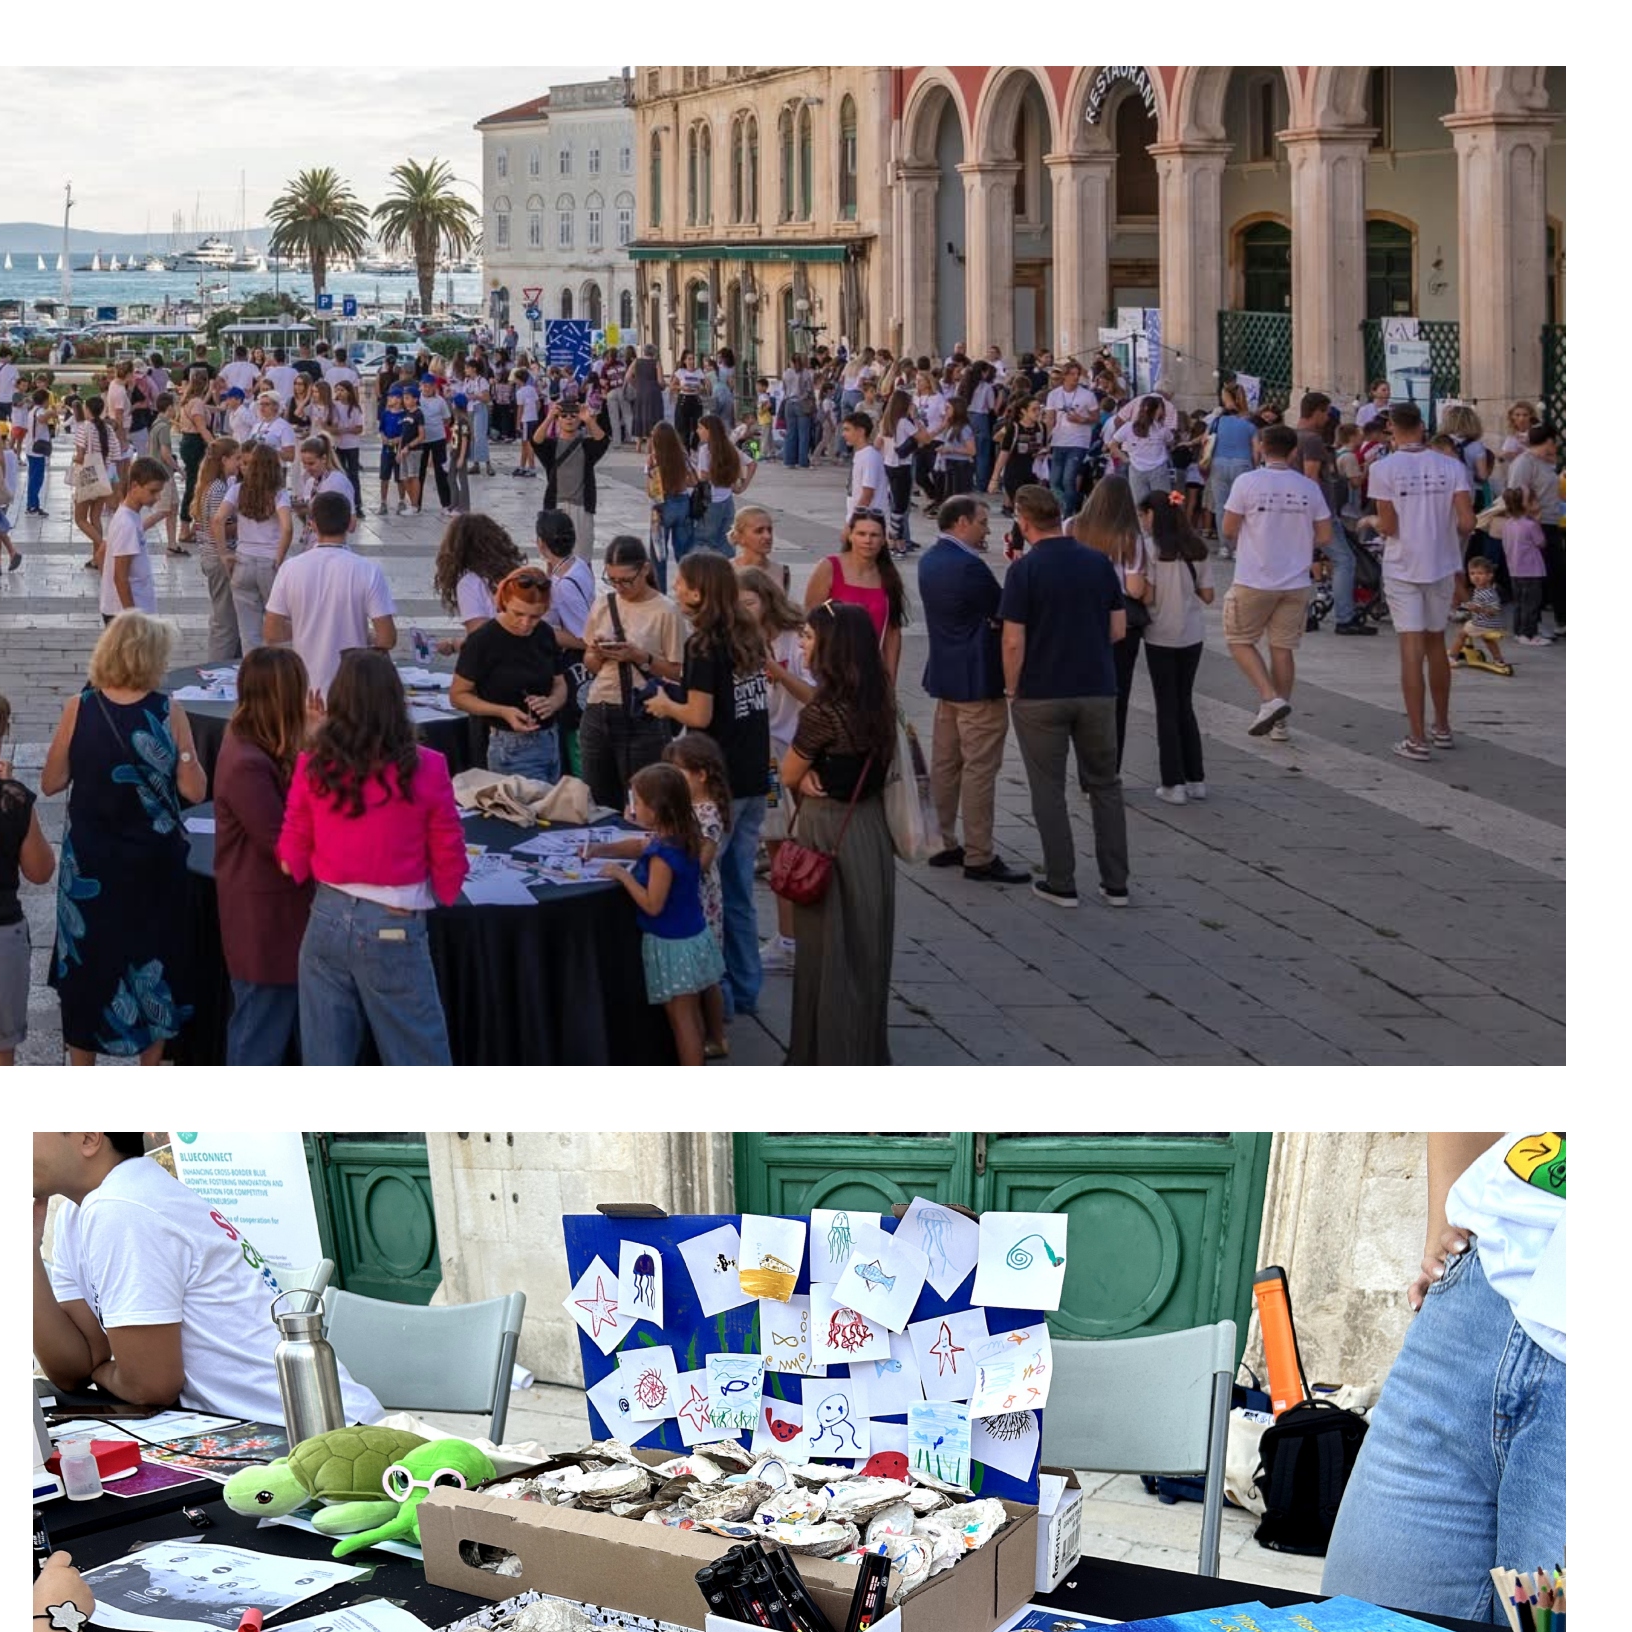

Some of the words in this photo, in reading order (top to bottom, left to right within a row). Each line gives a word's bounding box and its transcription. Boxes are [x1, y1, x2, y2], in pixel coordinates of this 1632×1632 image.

[1086, 66, 1157, 124] RESTAURANT
[179, 1152, 233, 1162] BLUECONNECT
[182, 1168, 214, 1176] ENHANCING
[213, 1169, 252, 1177] CROSS-BORDER
[253, 1169, 267, 1177] BLUE
[209, 1178, 238, 1186] FOSTERING
[237, 1179, 272, 1187] INNOVATION
[272, 1179, 284, 1187] AND
[223, 1188, 234, 1196] FOR
[234, 1188, 269, 1197] COMPETITIVE
[239, 1216, 271, 1225] cooperation
[271, 1216, 279, 1225] for
